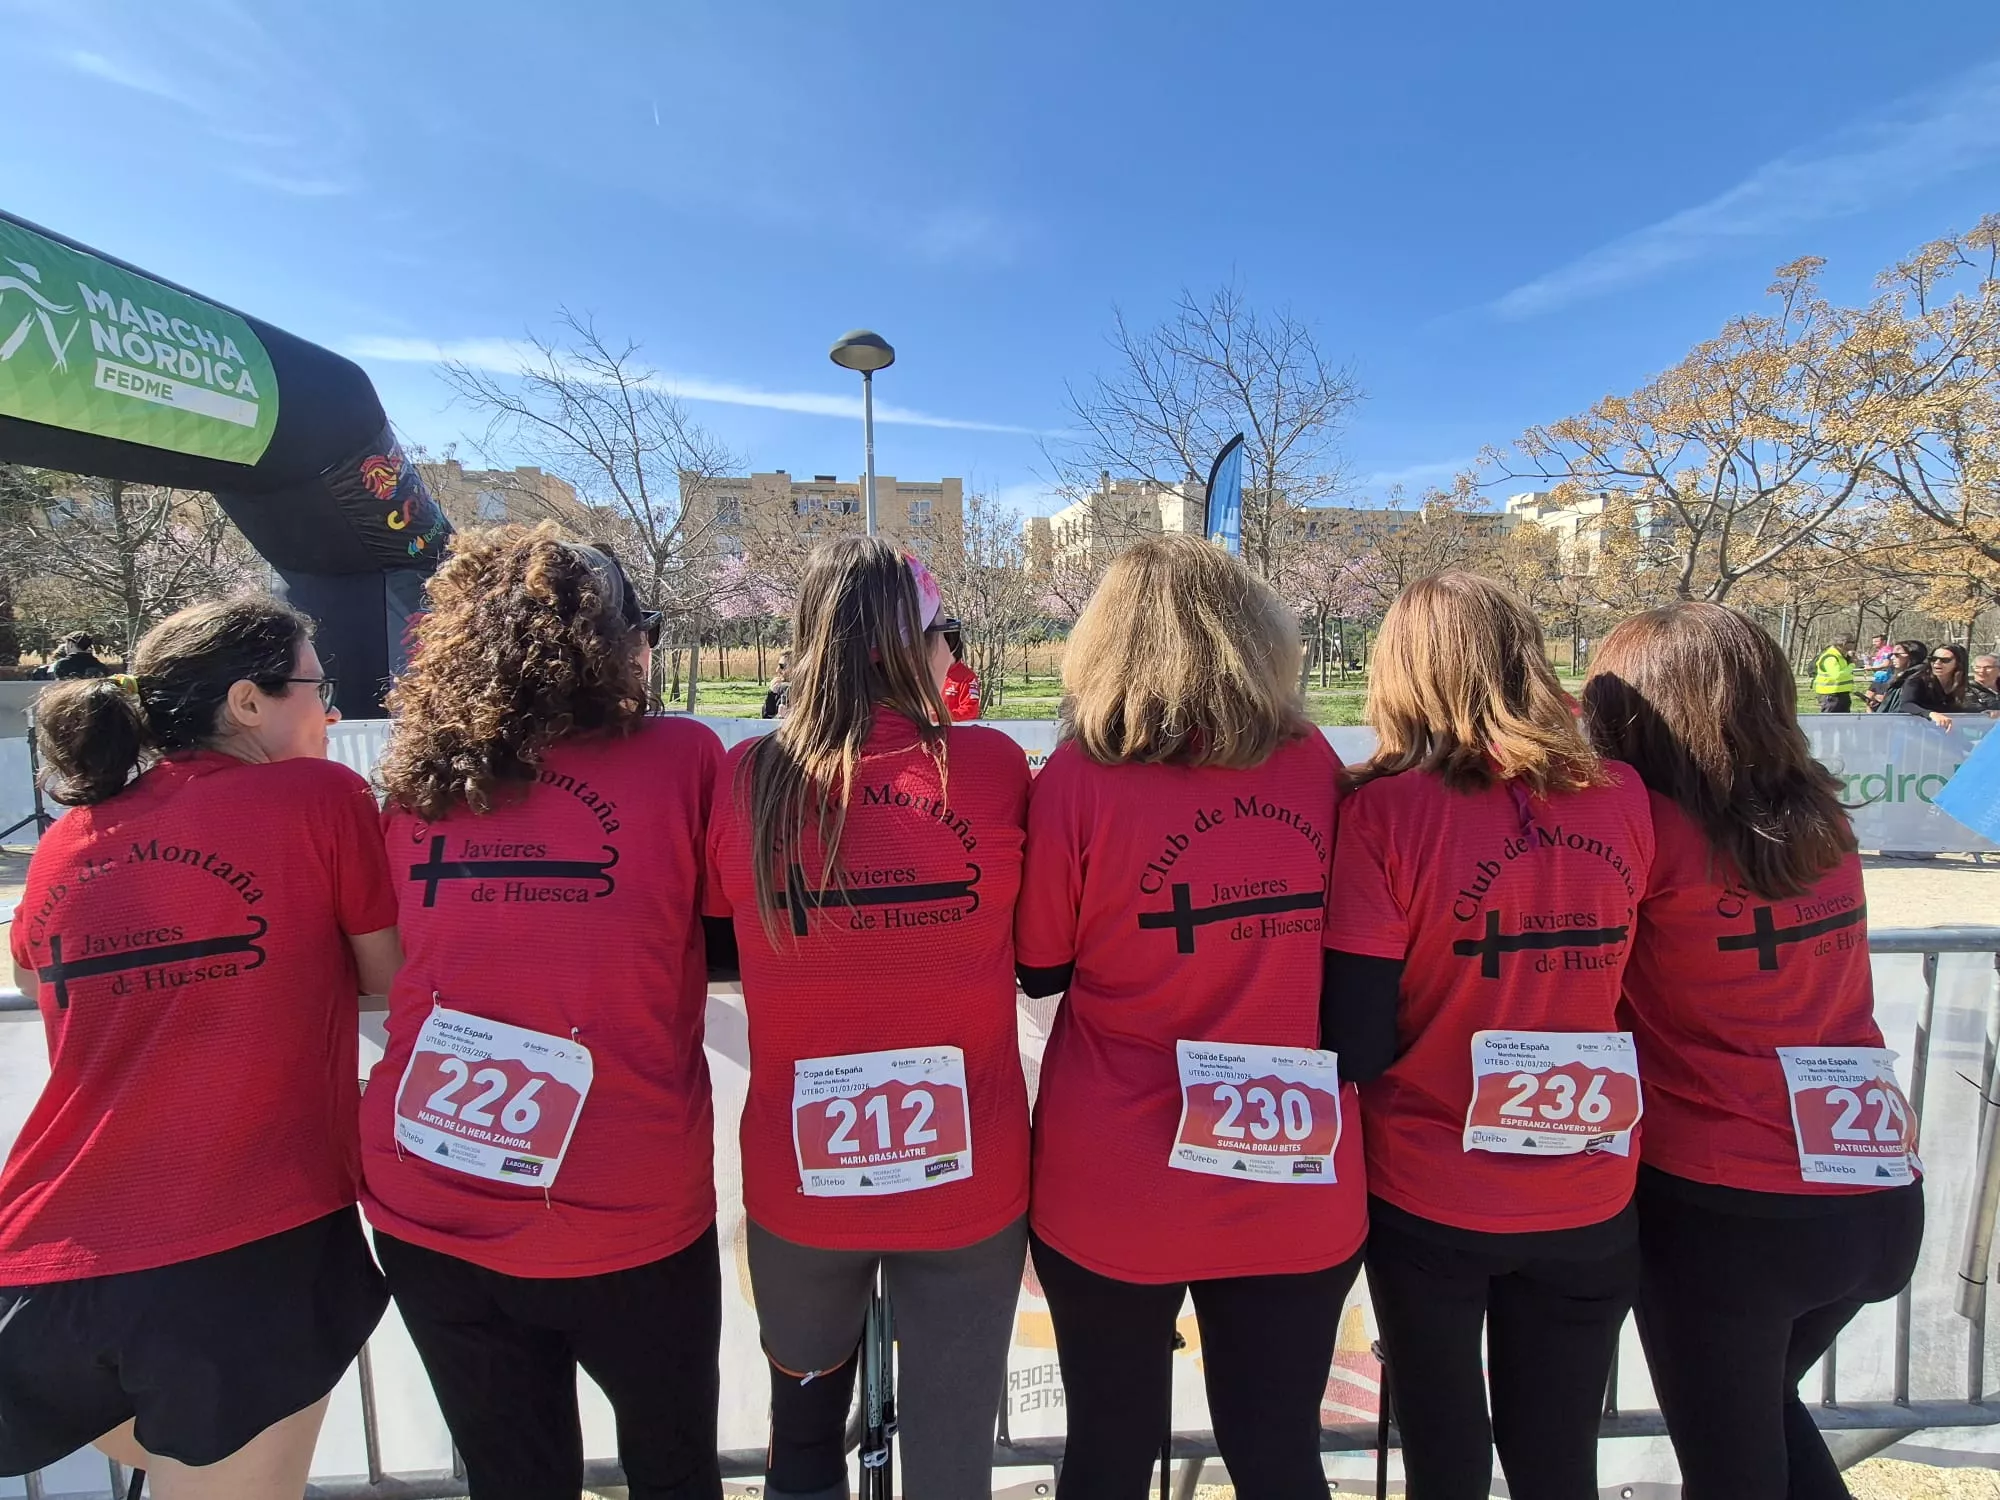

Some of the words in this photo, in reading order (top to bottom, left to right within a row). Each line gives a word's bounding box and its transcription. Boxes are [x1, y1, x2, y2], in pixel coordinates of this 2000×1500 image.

[77, 281, 245, 364] MARCHA
[89, 319, 259, 399] NÓRDICA
[103, 366, 173, 400] FEDME
[540, 768, 620, 835] ontaña
[861, 783, 977, 852] Montaña
[459, 839, 547, 859] Javieres
[1140, 833, 1190, 894] Club
[1194, 808, 1225, 832] de
[1233, 795, 1327, 863] Montaña
[1211, 878, 1288, 903] Javieres
[1453, 859, 1501, 922] Club
[1504, 836, 1529, 860] de
[28, 884, 68, 948] Club
[77, 858, 117, 884] de
[127, 839, 265, 905] Montaña
[471, 882, 496, 901] de
[503, 881, 589, 902] Huesca
[850, 910, 875, 930] de
[884, 906, 962, 929] Huesca
[1231, 922, 1253, 940] de
[1260, 917, 1321, 938] Huesca
[1519, 911, 1597, 931] Javieres
[82, 925, 184, 956] Javieres
[1814, 939, 1832, 957] de
[1536, 954, 1557, 973] de
[145, 964, 239, 991] Huesca
[432, 1018, 453, 1031] Copa
[453, 1025, 464, 1034] de
[464, 1027, 494, 1041] España
[425, 1035, 447, 1048] UTEBO
[451, 1044, 493, 1060] 01/03/2026
[1189, 1051, 1208, 1062] Copa
[1209, 1052, 1218, 1061] de
[1219, 1053, 1246, 1063] España
[1485, 1041, 1508, 1050] Copa
[1508, 1042, 1519, 1050] de
[1520, 1043, 1550, 1052] España
[803, 1070, 824, 1080] Copa
[824, 1068, 834, 1076] de
[835, 1066, 863, 1076] España
[1795, 1058, 1816, 1066] Copa
[1828, 1058, 1858, 1066] España
[1189, 1070, 1211, 1078] UTEBO
[425, 1058, 547, 1134] 226
[801, 1087, 825, 1096] UTEBO
[1499, 1074, 1611, 1123] 236
[825, 1089, 938, 1155] 212
[1212, 1084, 1313, 1141] 230
[1826, 1088, 1907, 1141] 229
[417, 1110, 444, 1127] MARTA
[444, 1119, 456, 1130] DE
[456, 1123, 467, 1134] LA
[467, 1126, 492, 1142] HERA
[493, 1133, 532, 1150] ZAMORA
[1501, 1117, 1551, 1129] ESPERANZA
[1552, 1123, 1586, 1132] CAVERO
[840, 1155, 867, 1166] MARIA
[868, 1152, 898, 1163] GRASA
[899, 1147, 927, 1159] LATRE
[1217, 1139, 1250, 1151] SUSANA
[1252, 1143, 1279, 1152] BORAU
[1279, 1144, 1302, 1153] BETES
[1833, 1143, 1879, 1153] PATRICIA
[505, 1159, 532, 1170] LABORAL
[1824, 1164, 1856, 1174] Utebo
[820, 1176, 845, 1187] Utebo
